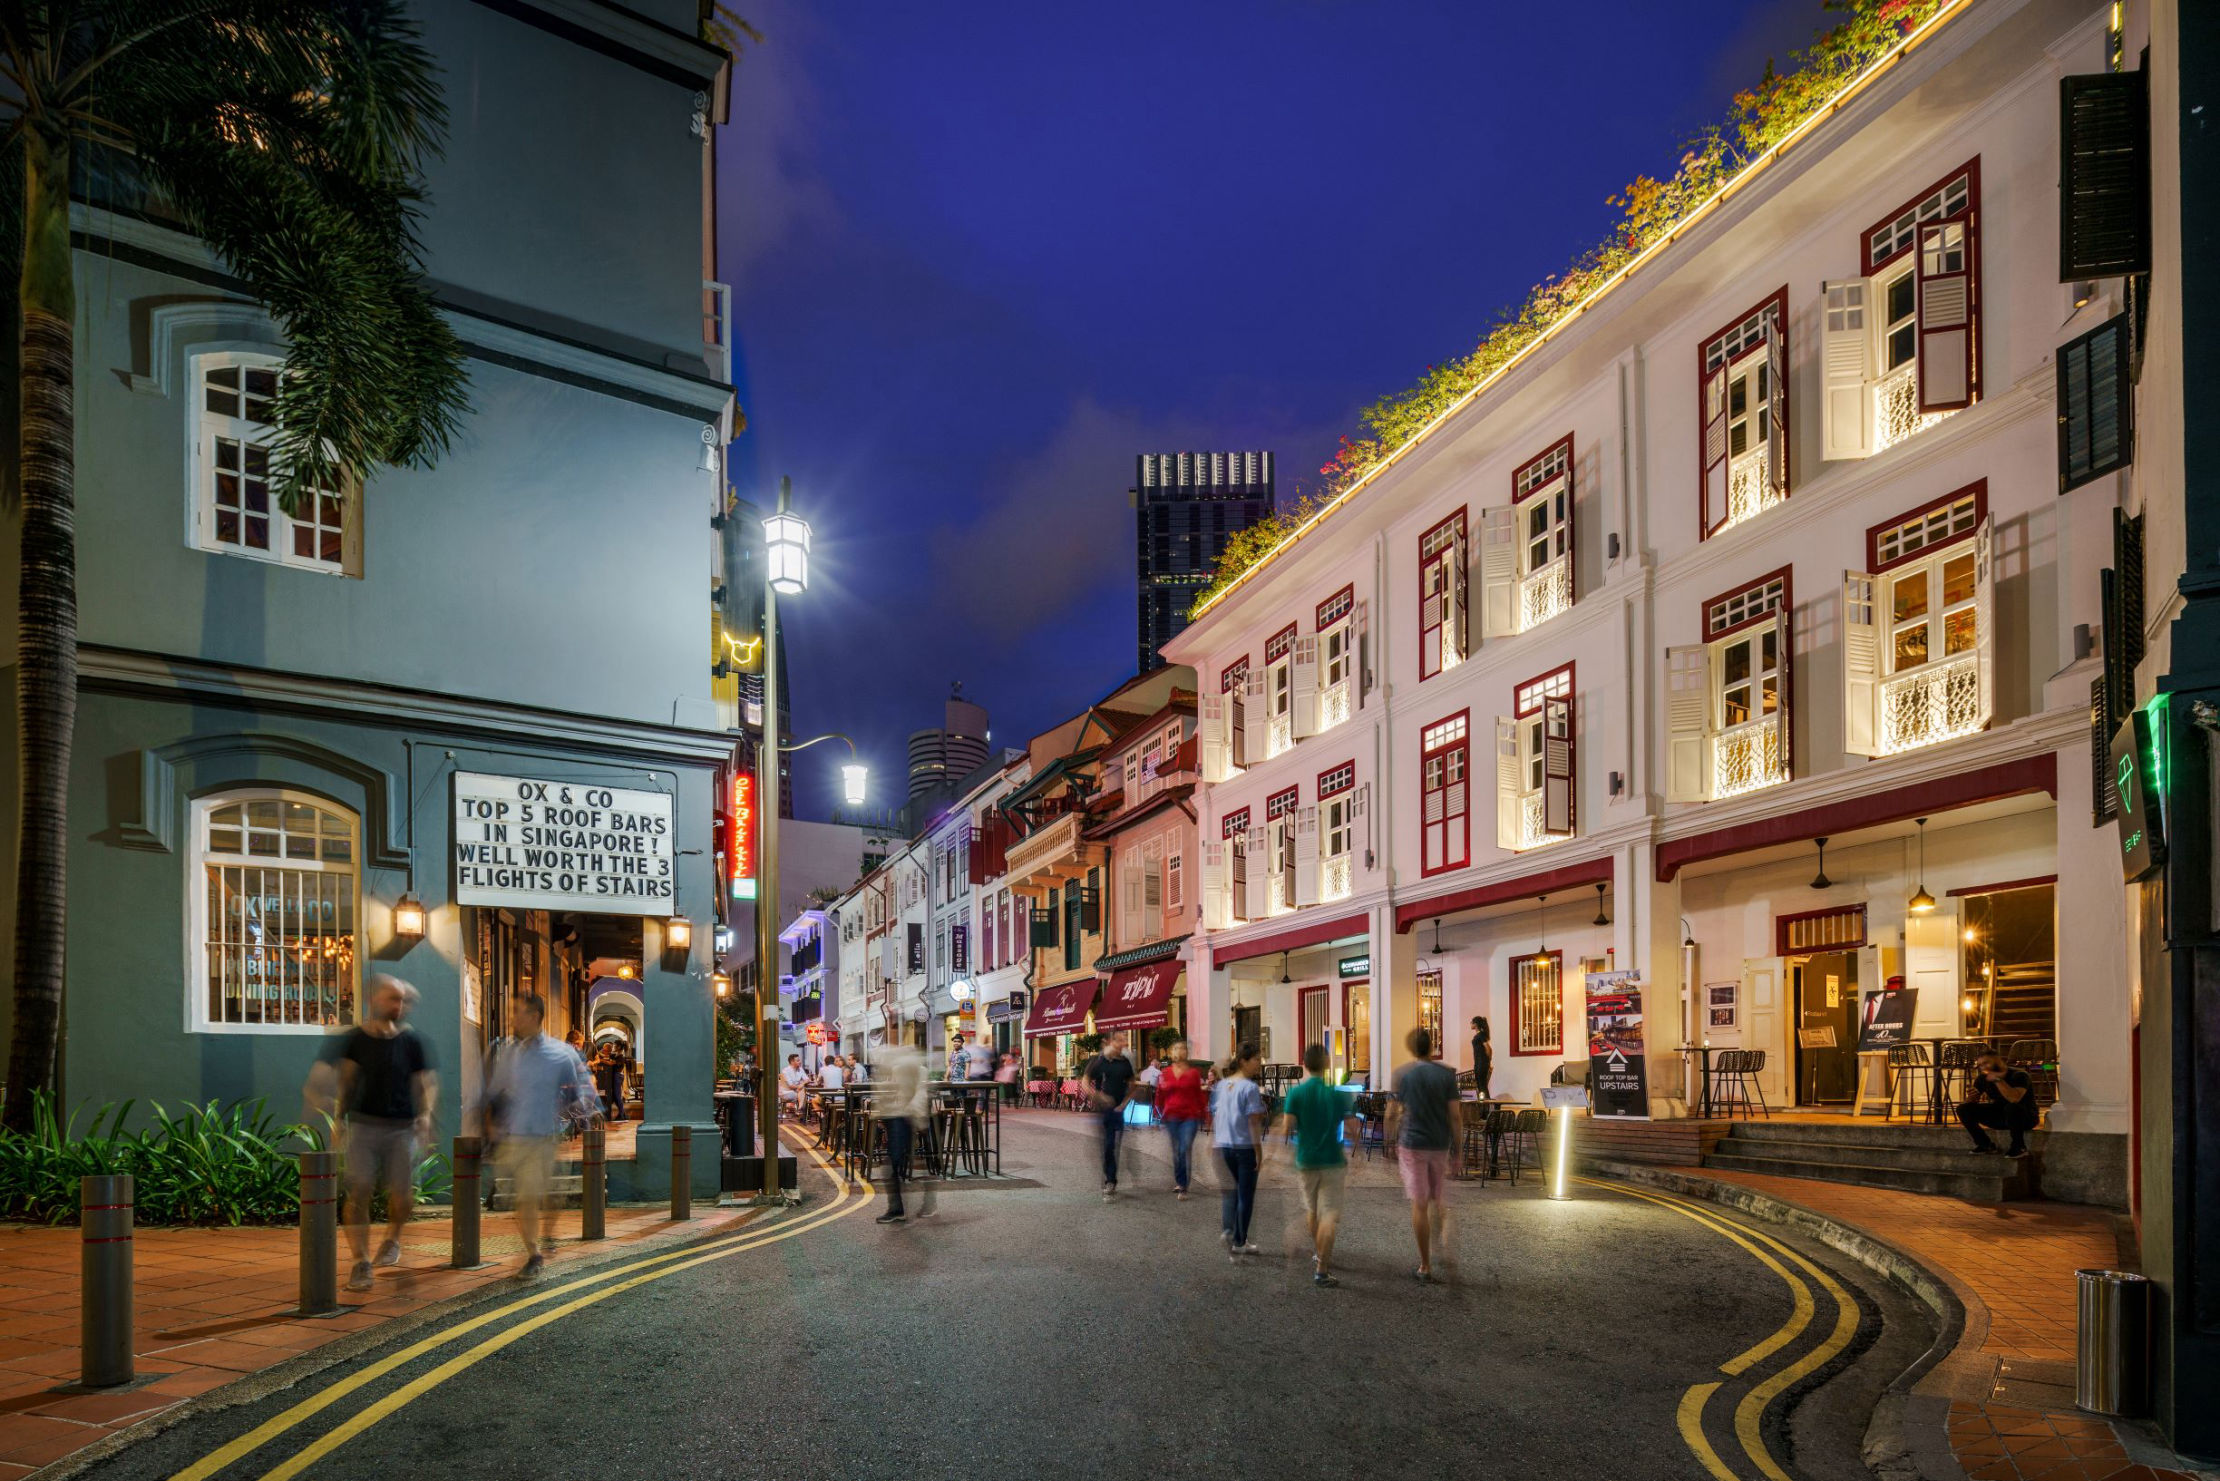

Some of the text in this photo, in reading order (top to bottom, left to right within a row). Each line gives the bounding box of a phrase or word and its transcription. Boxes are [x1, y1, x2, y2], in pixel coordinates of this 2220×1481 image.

[518, 782, 613, 808] OX & CO
[462, 799, 666, 835] TOP 5 ROOF BARS
[484, 823, 507, 842] IN
[457, 843, 669, 876] WELL WORTH THE 3
[459, 866, 672, 897] FLIGHTS OF STAIRS
[1599, 1081, 1639, 1090] UPSTAIRS
